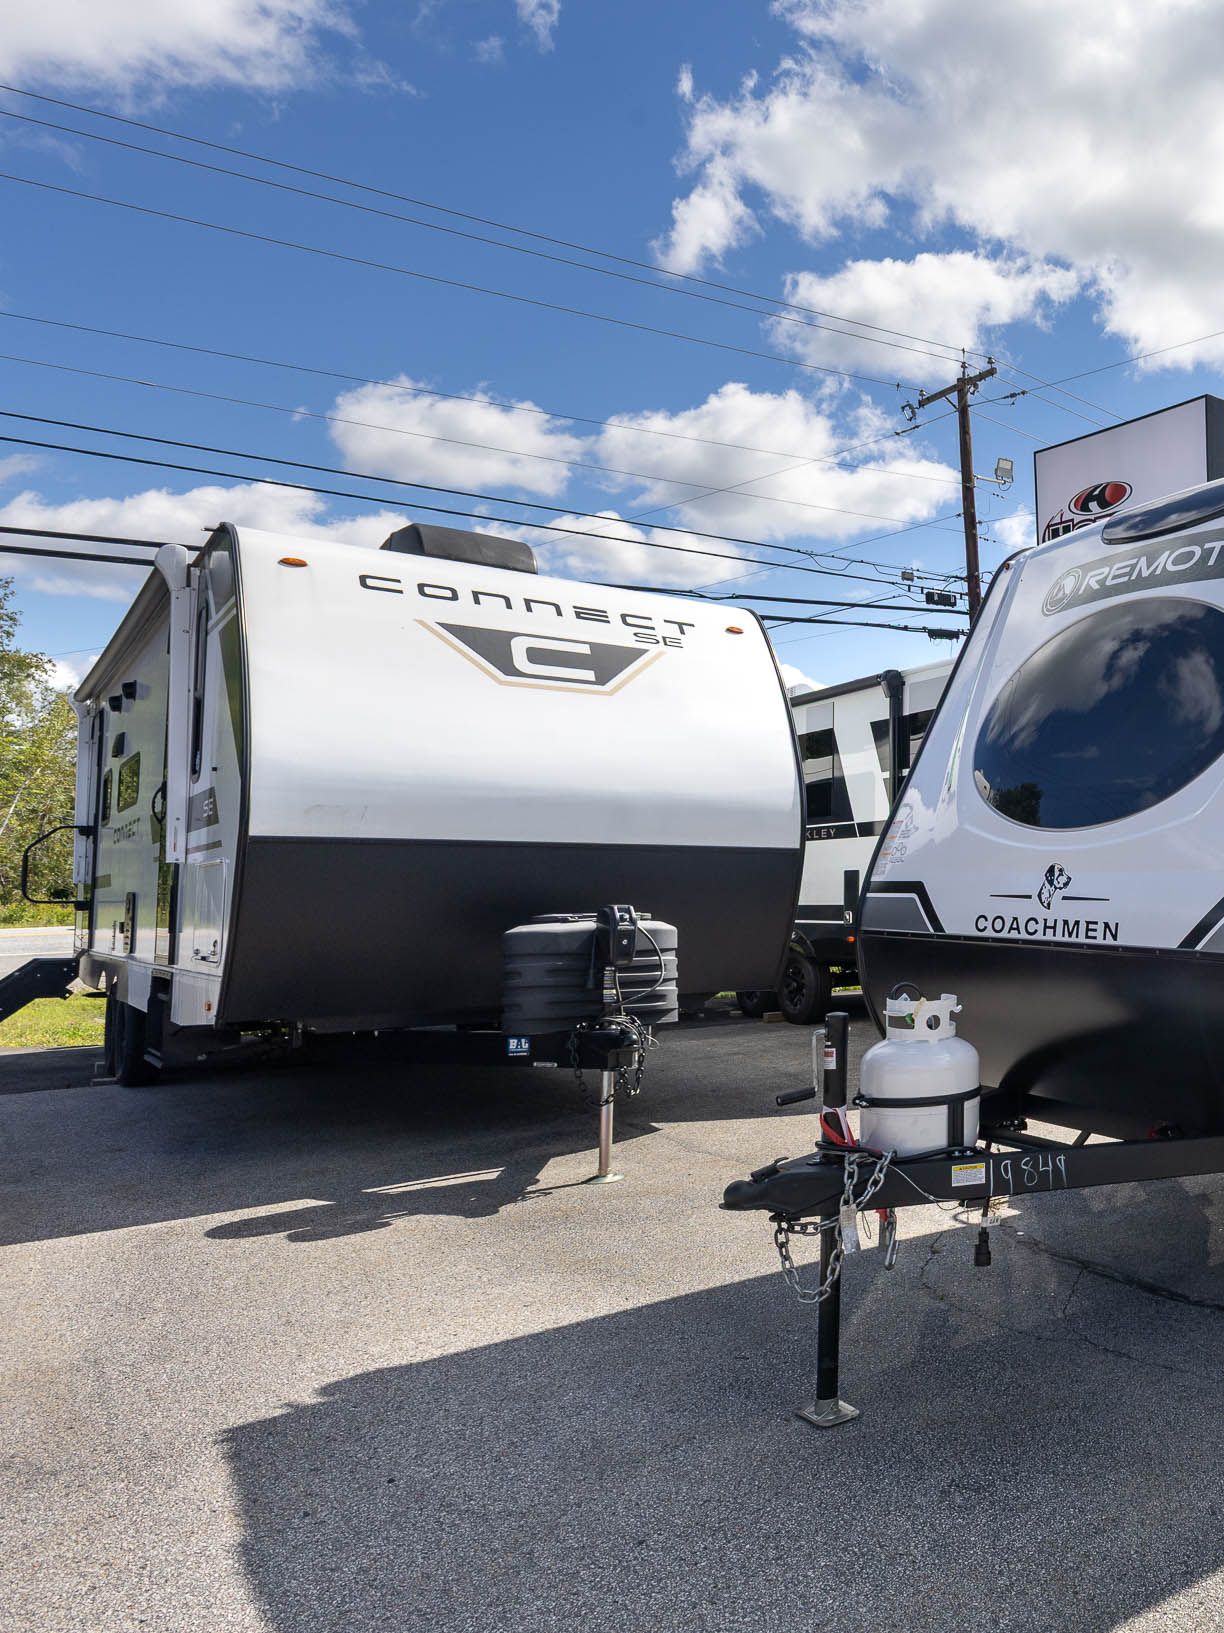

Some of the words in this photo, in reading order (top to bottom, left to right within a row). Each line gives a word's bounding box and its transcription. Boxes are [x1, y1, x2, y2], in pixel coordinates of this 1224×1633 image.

[359, 574, 695, 636] CONNECT
[633, 631, 684, 648] SE
[975, 914, 1119, 942] COACHMEN
[989, 1152, 1068, 1196] 19849
